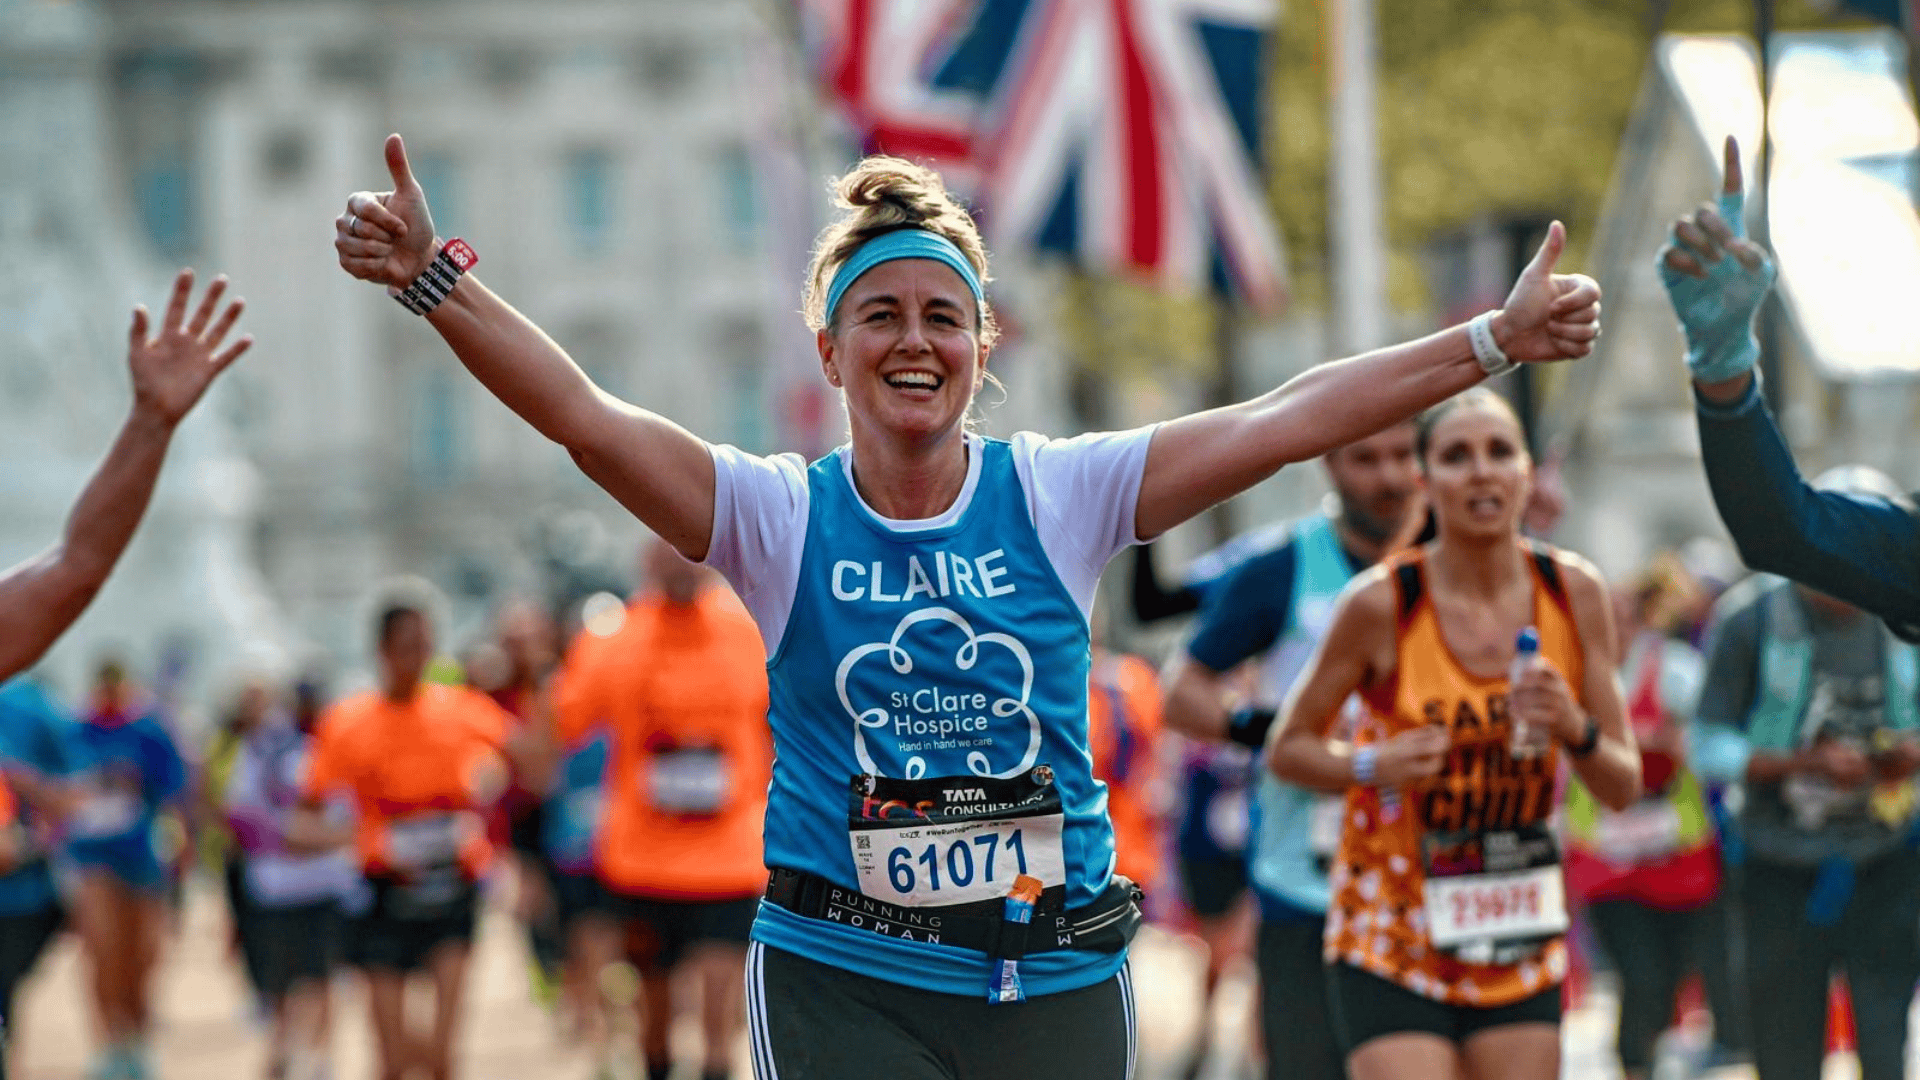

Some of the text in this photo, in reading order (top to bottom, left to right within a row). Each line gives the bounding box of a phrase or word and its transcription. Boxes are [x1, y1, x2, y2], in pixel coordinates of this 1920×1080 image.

[832, 548, 1016, 602] CLAIRE
[891, 686, 987, 713] St Clare
[894, 714, 988, 739] Hospice
[899, 737, 993, 752] Hand in hand we care
[942, 788, 987, 802] TATA
[888, 829, 1028, 894] 61071
[831, 889, 942, 928] RUNNING
[827, 907, 941, 945] WOMAN
